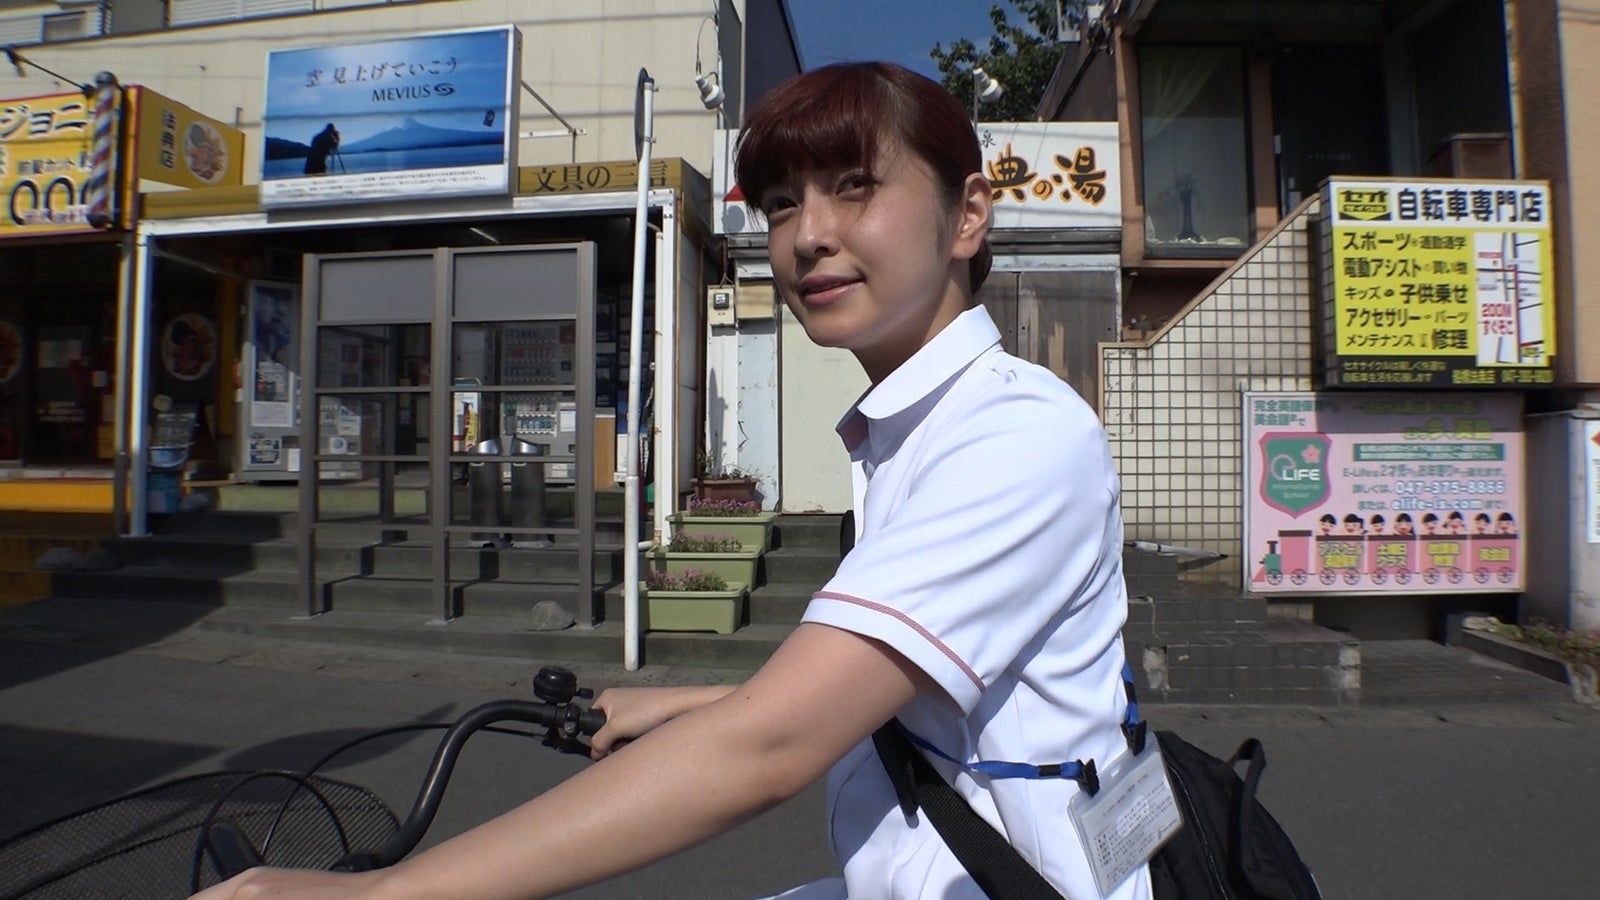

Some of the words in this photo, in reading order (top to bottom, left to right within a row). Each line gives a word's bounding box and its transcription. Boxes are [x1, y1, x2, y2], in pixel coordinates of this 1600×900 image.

[331, 56, 458, 85] 見上げていこう
[372, 84, 431, 102] MEVIUS
[1398, 187, 1543, 222] 自転車専門店
